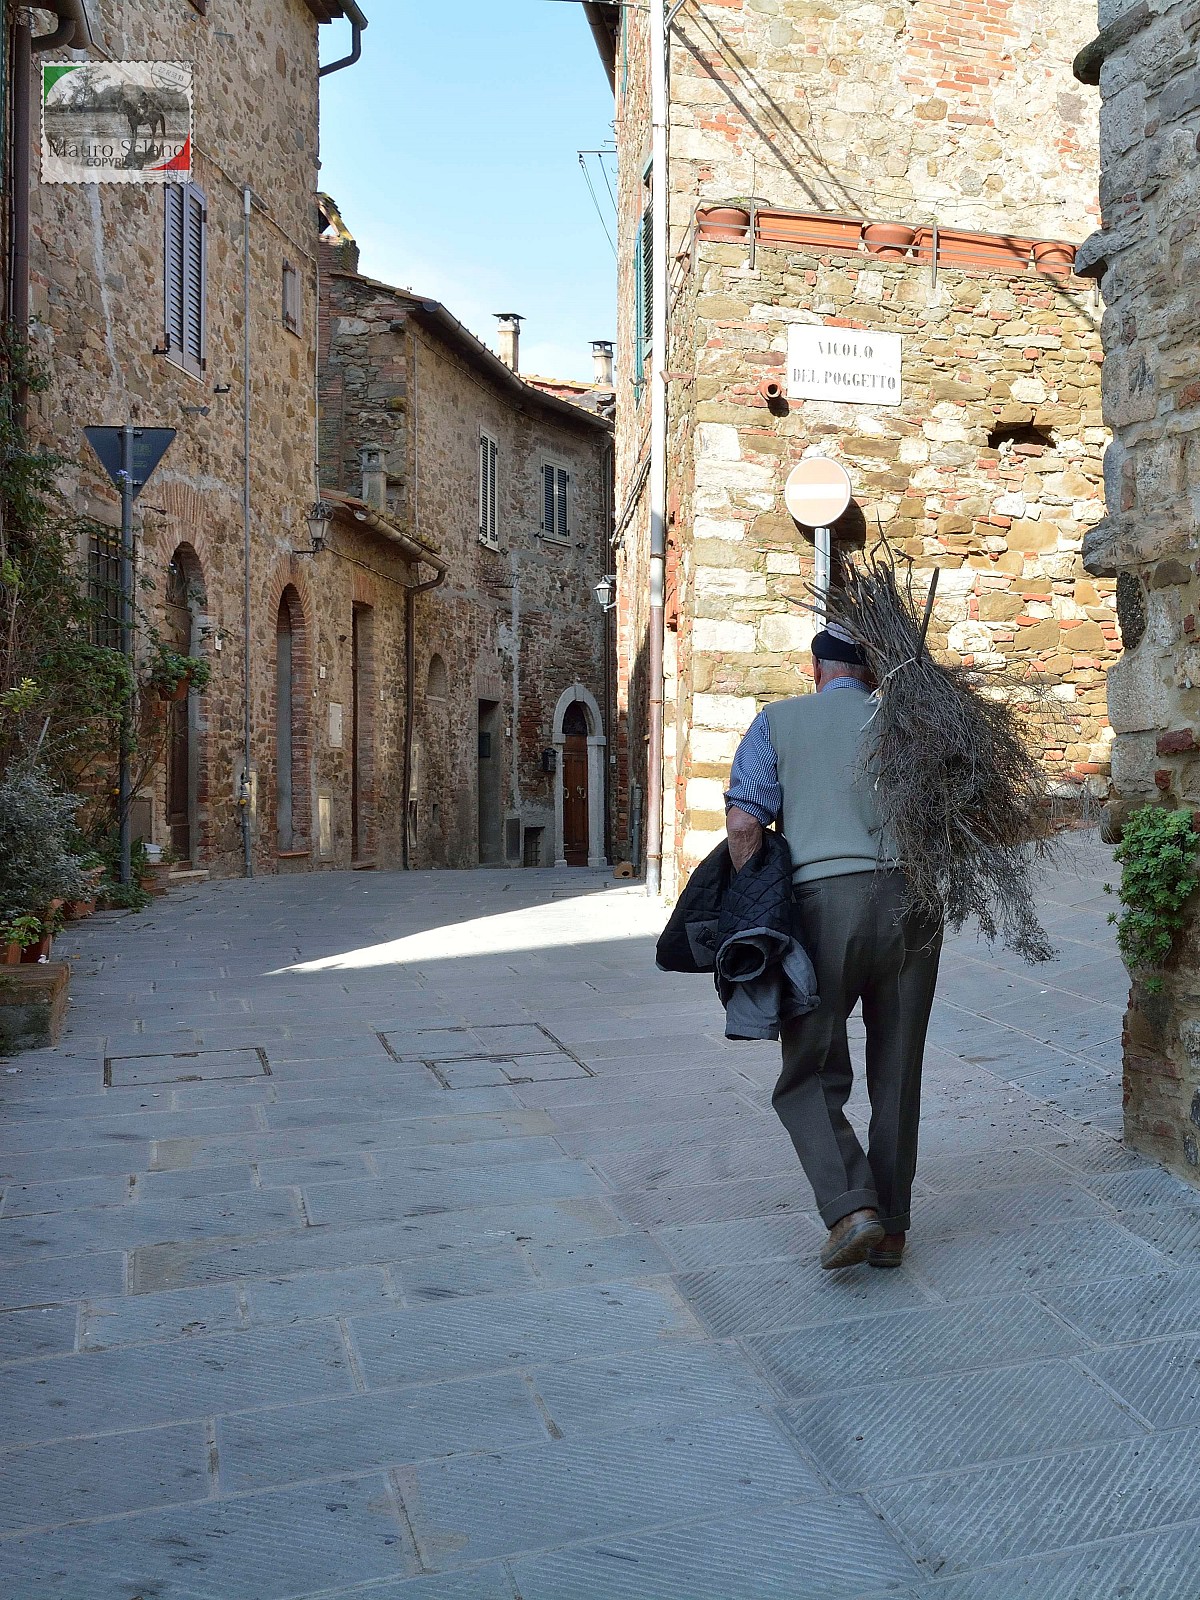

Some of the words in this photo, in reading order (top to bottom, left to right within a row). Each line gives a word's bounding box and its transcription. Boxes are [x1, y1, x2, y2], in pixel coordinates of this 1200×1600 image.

[818, 341, 873, 359] VICOLO
[793, 368, 820, 384] DEL
[824, 370, 896, 390] POGGETTO
